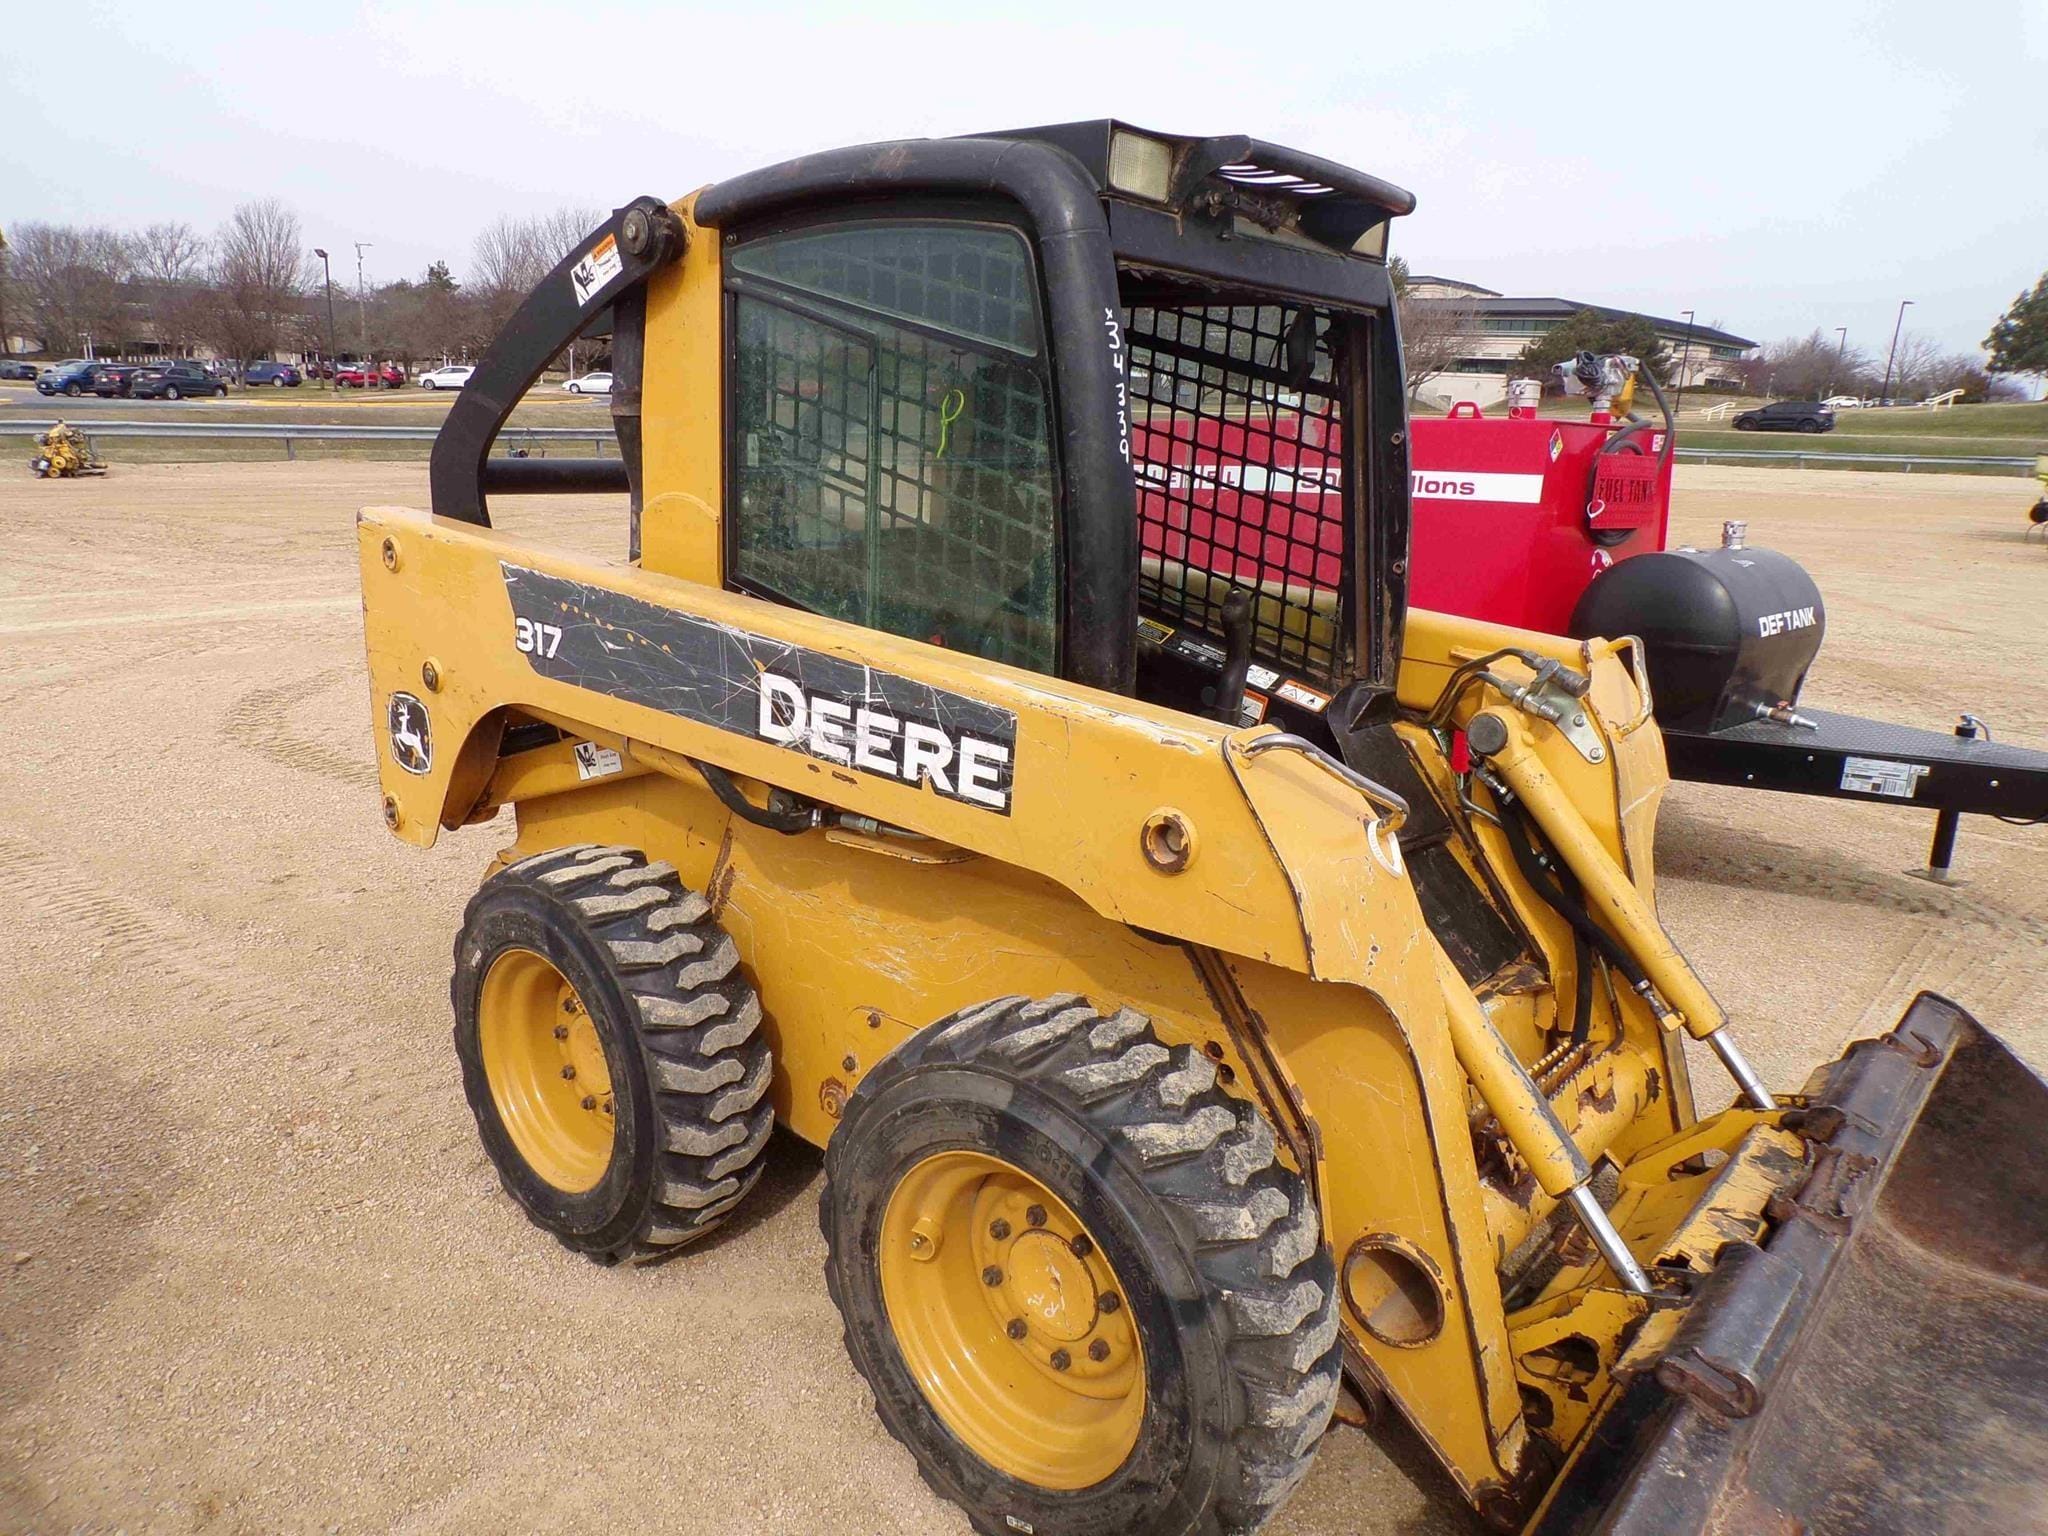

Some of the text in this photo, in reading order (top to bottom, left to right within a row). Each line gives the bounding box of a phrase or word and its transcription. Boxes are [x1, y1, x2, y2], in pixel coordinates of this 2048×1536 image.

[515, 616, 563, 660] 317
[1758, 606, 1817, 638] DEF TANK
[758, 671, 1010, 809] DEERE
